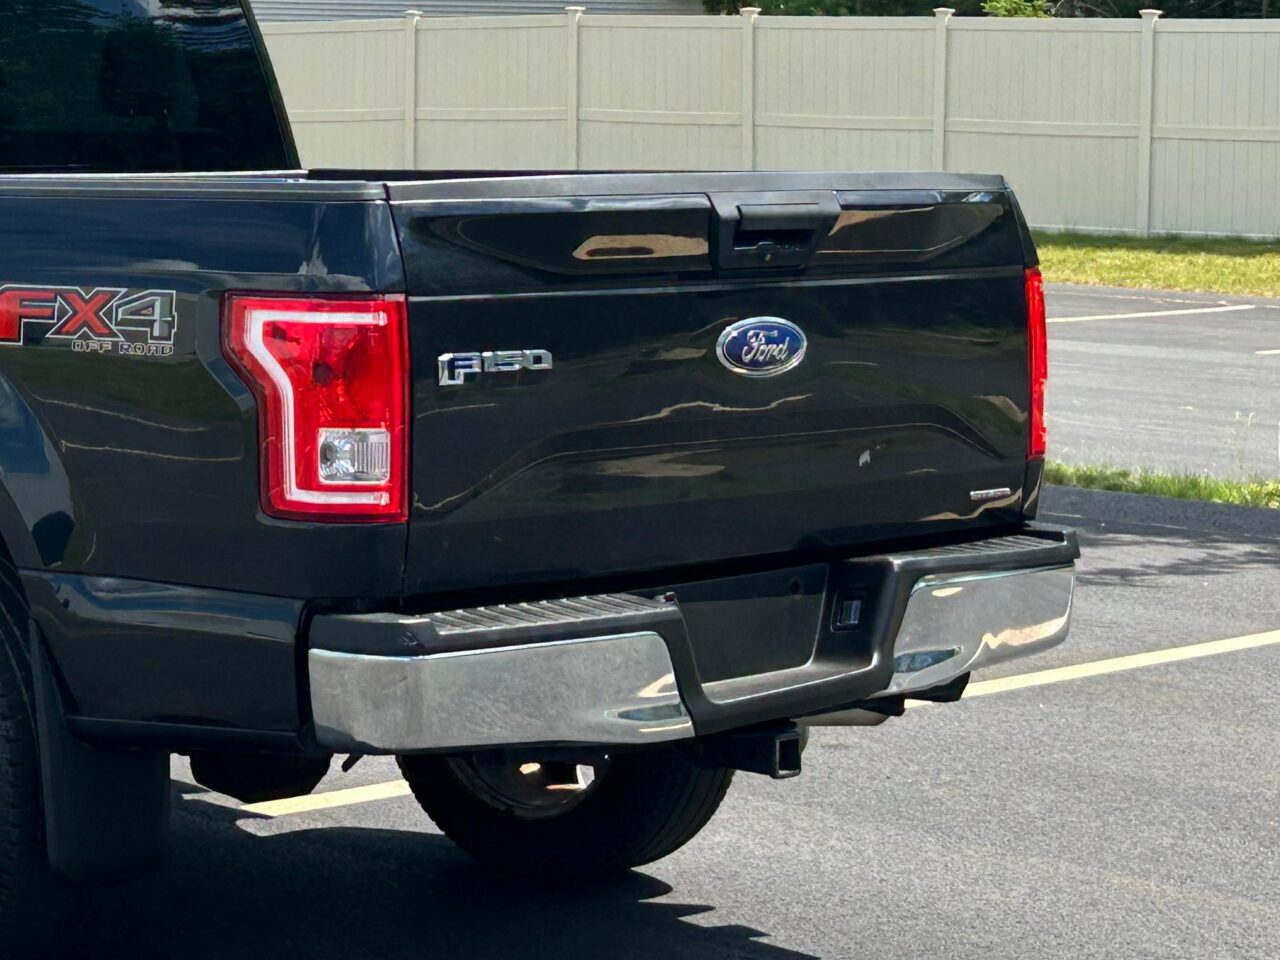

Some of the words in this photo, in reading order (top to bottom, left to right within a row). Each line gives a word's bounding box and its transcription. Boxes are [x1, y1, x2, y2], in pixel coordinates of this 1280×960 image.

[71, 340, 113, 353] OFF
[118, 341, 174, 356] ROAD
[741, 329, 790, 363] Ford
